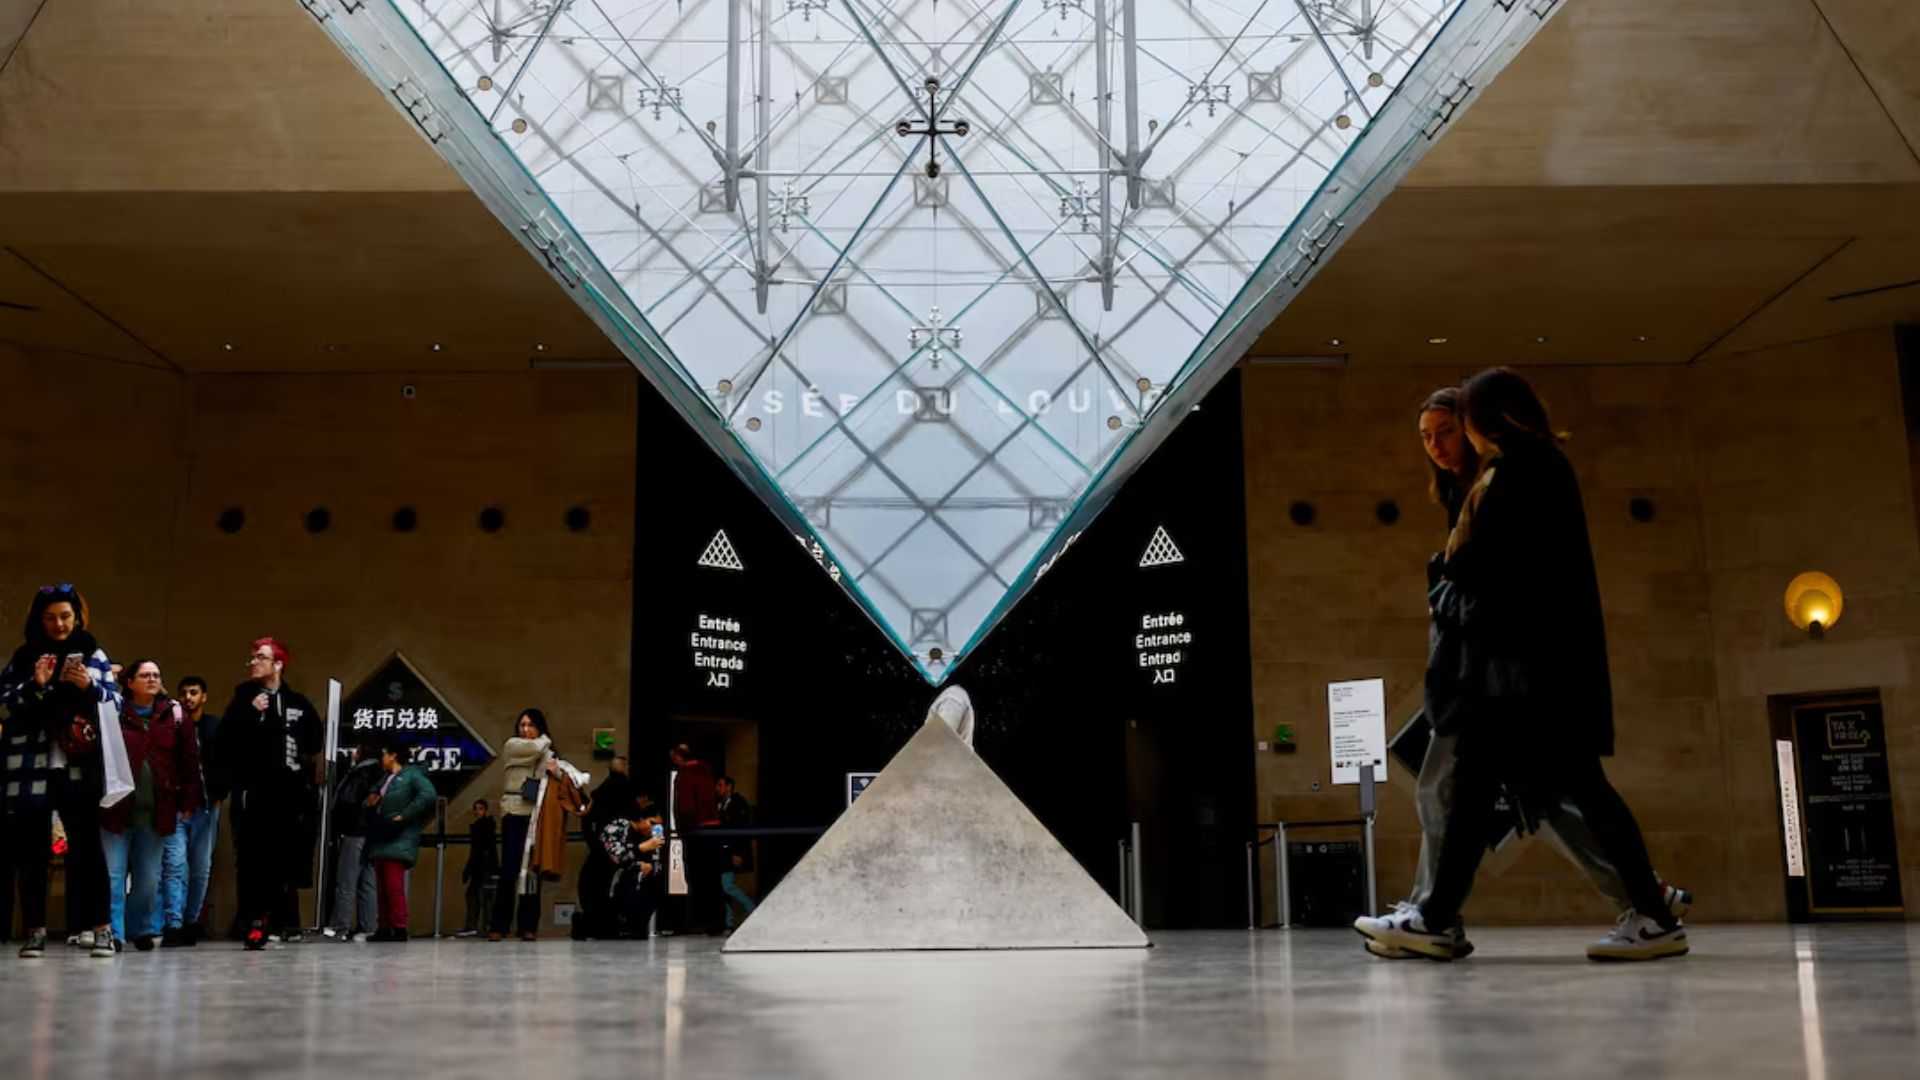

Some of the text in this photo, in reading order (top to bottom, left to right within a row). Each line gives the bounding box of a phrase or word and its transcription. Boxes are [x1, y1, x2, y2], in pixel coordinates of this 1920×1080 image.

[896, 388, 958, 416] DU
[698, 614, 741, 632] Entrée
[1142, 611, 1184, 629] Entrée
[690, 632, 747, 652] Entrance
[1135, 632, 1192, 649] Entrance
[694, 651, 744, 670] Entrada
[707, 671, 730, 688] 入口
[1152, 668, 1175, 685] 入口
[352, 706, 440, 731] 货币兑换
